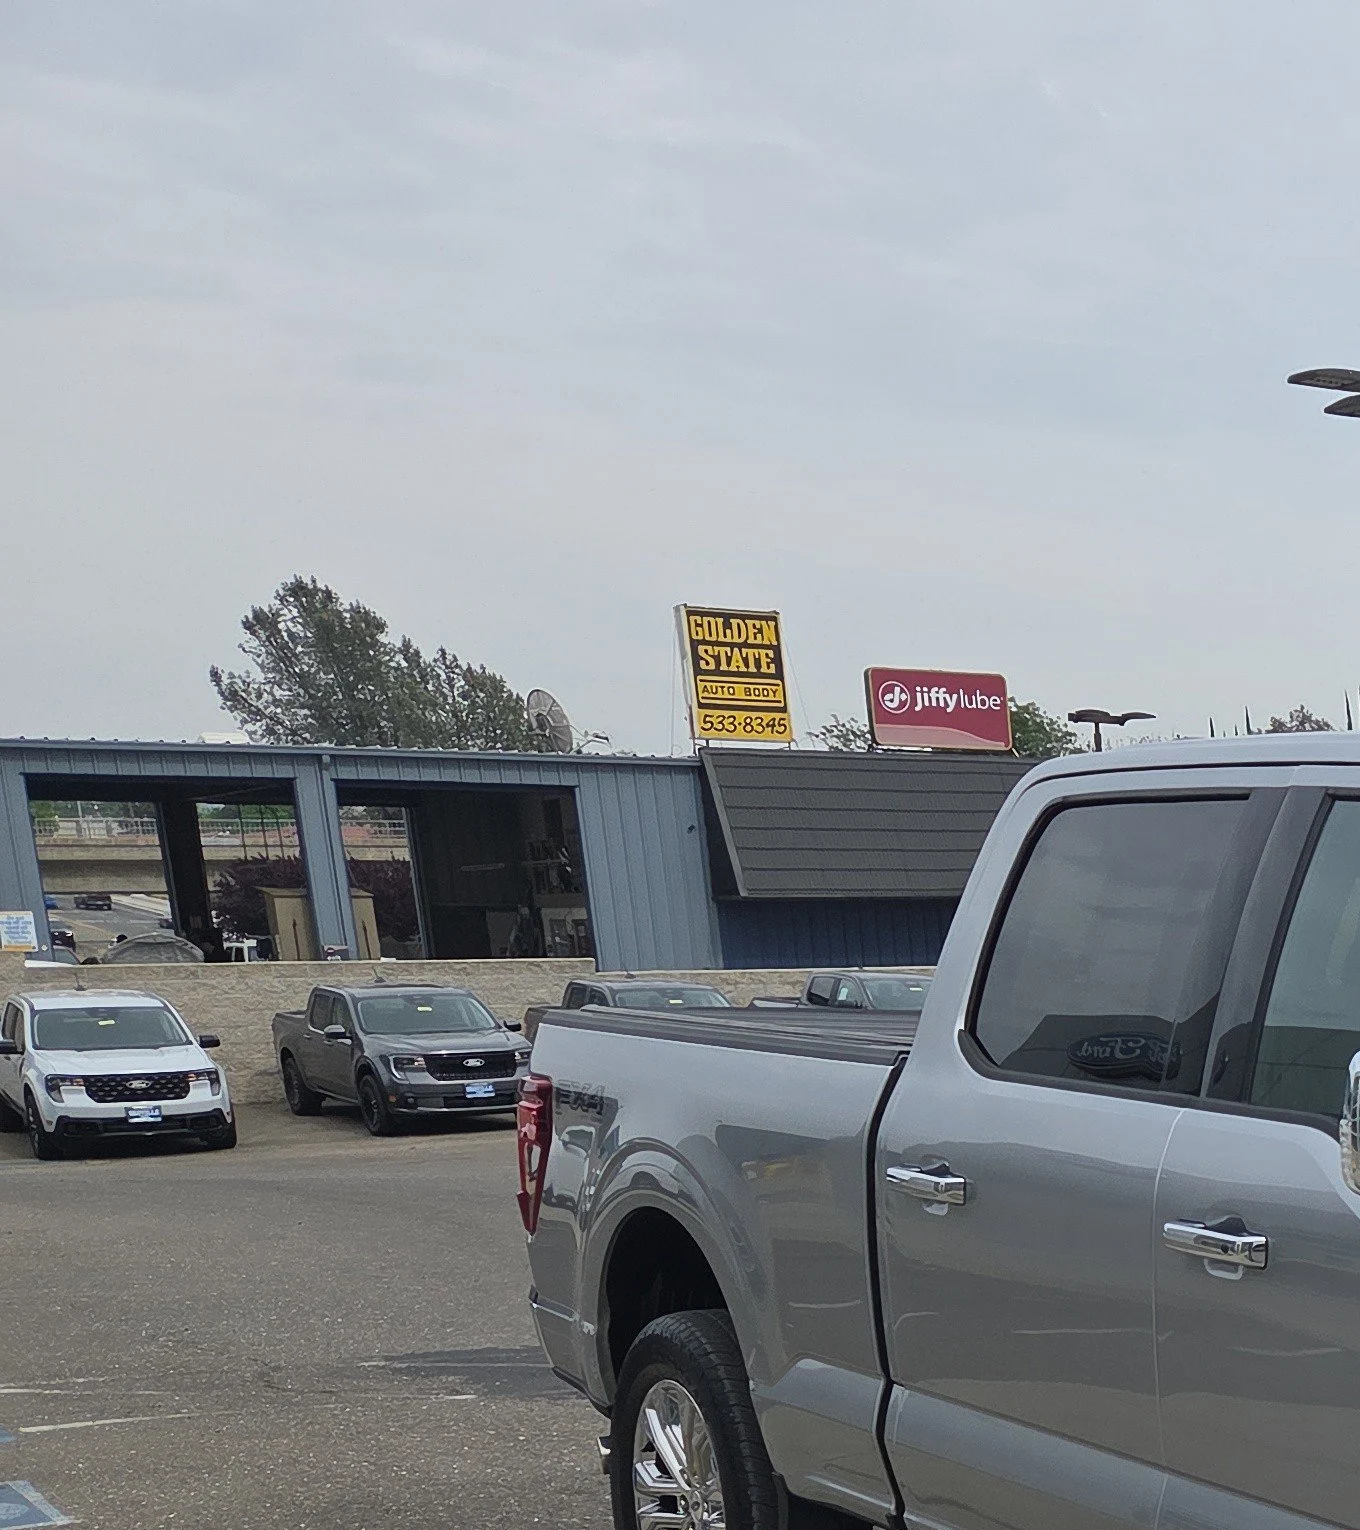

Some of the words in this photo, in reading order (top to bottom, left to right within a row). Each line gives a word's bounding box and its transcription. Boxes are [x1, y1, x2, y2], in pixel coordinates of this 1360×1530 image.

[689, 615, 778, 645] GOLDEN
[698, 645, 776, 674] STATE
[701, 684, 736, 696] AUTO
[744, 686, 779, 698] BODY
